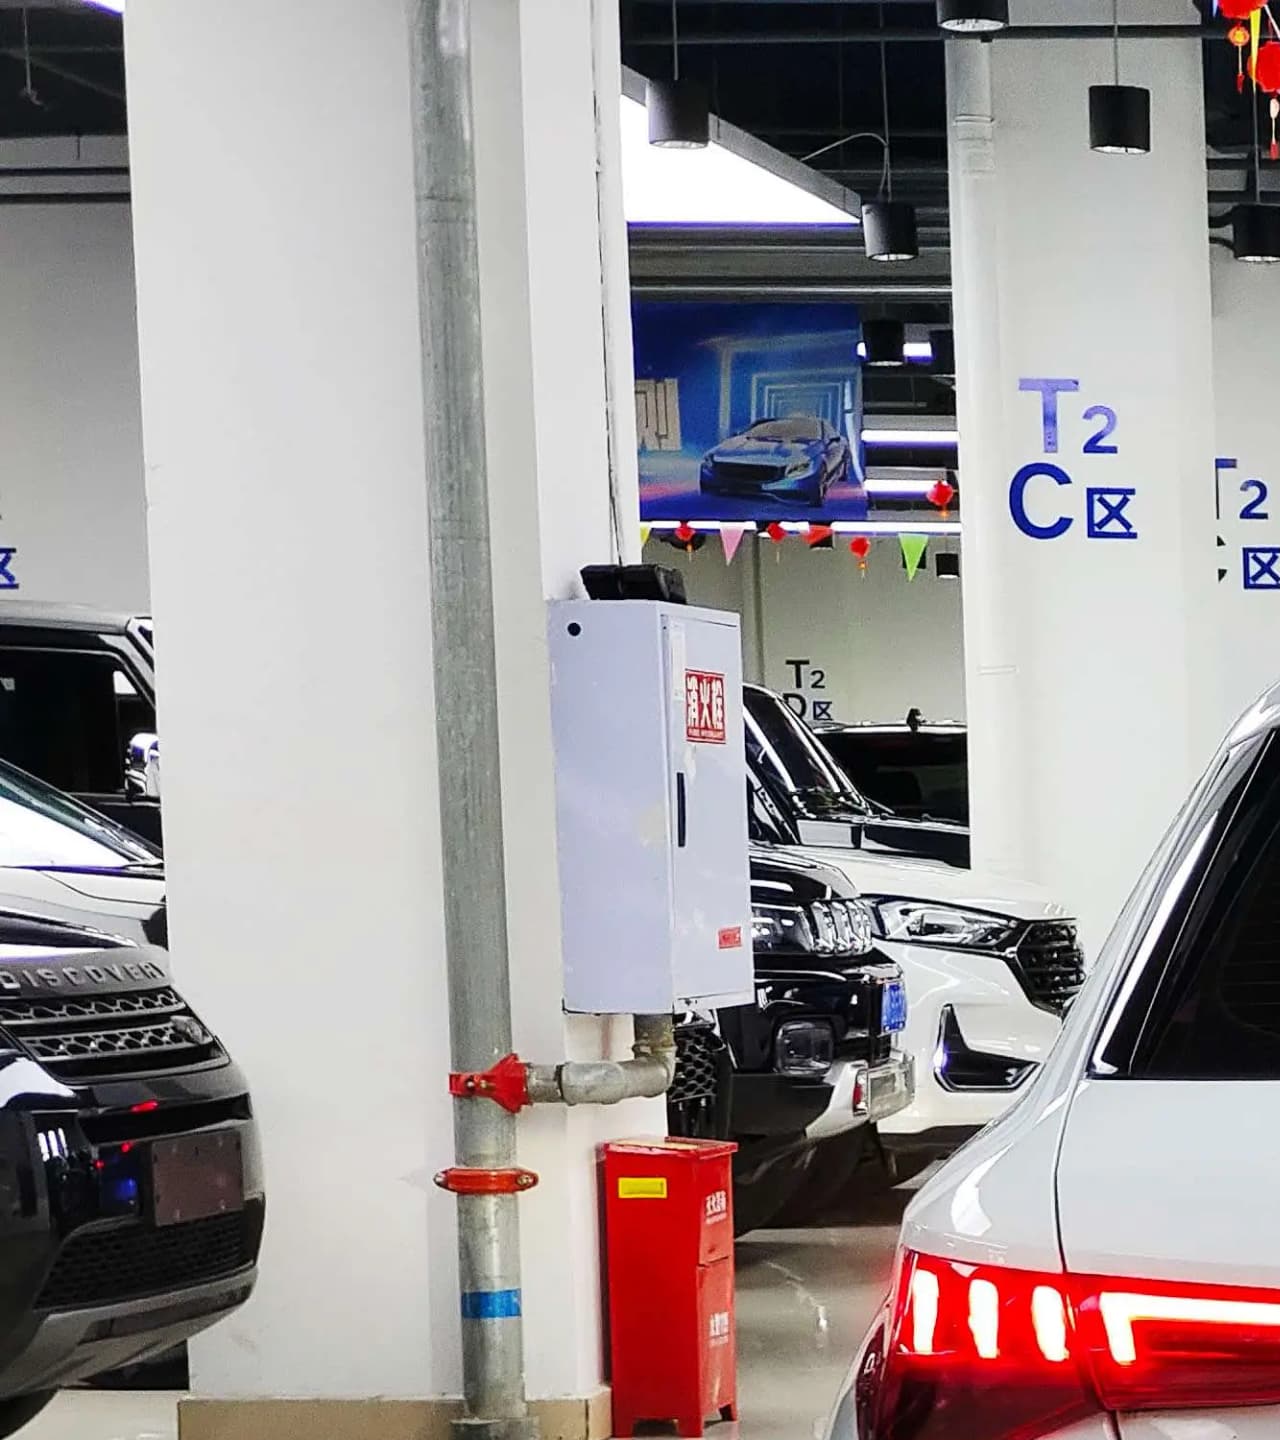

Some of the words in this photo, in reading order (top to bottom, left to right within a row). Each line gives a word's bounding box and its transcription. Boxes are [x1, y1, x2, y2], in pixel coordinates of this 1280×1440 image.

[1018, 378, 1118, 453] T2
[1009, 462, 1138, 539] C区
[785, 659, 825, 688] T2
